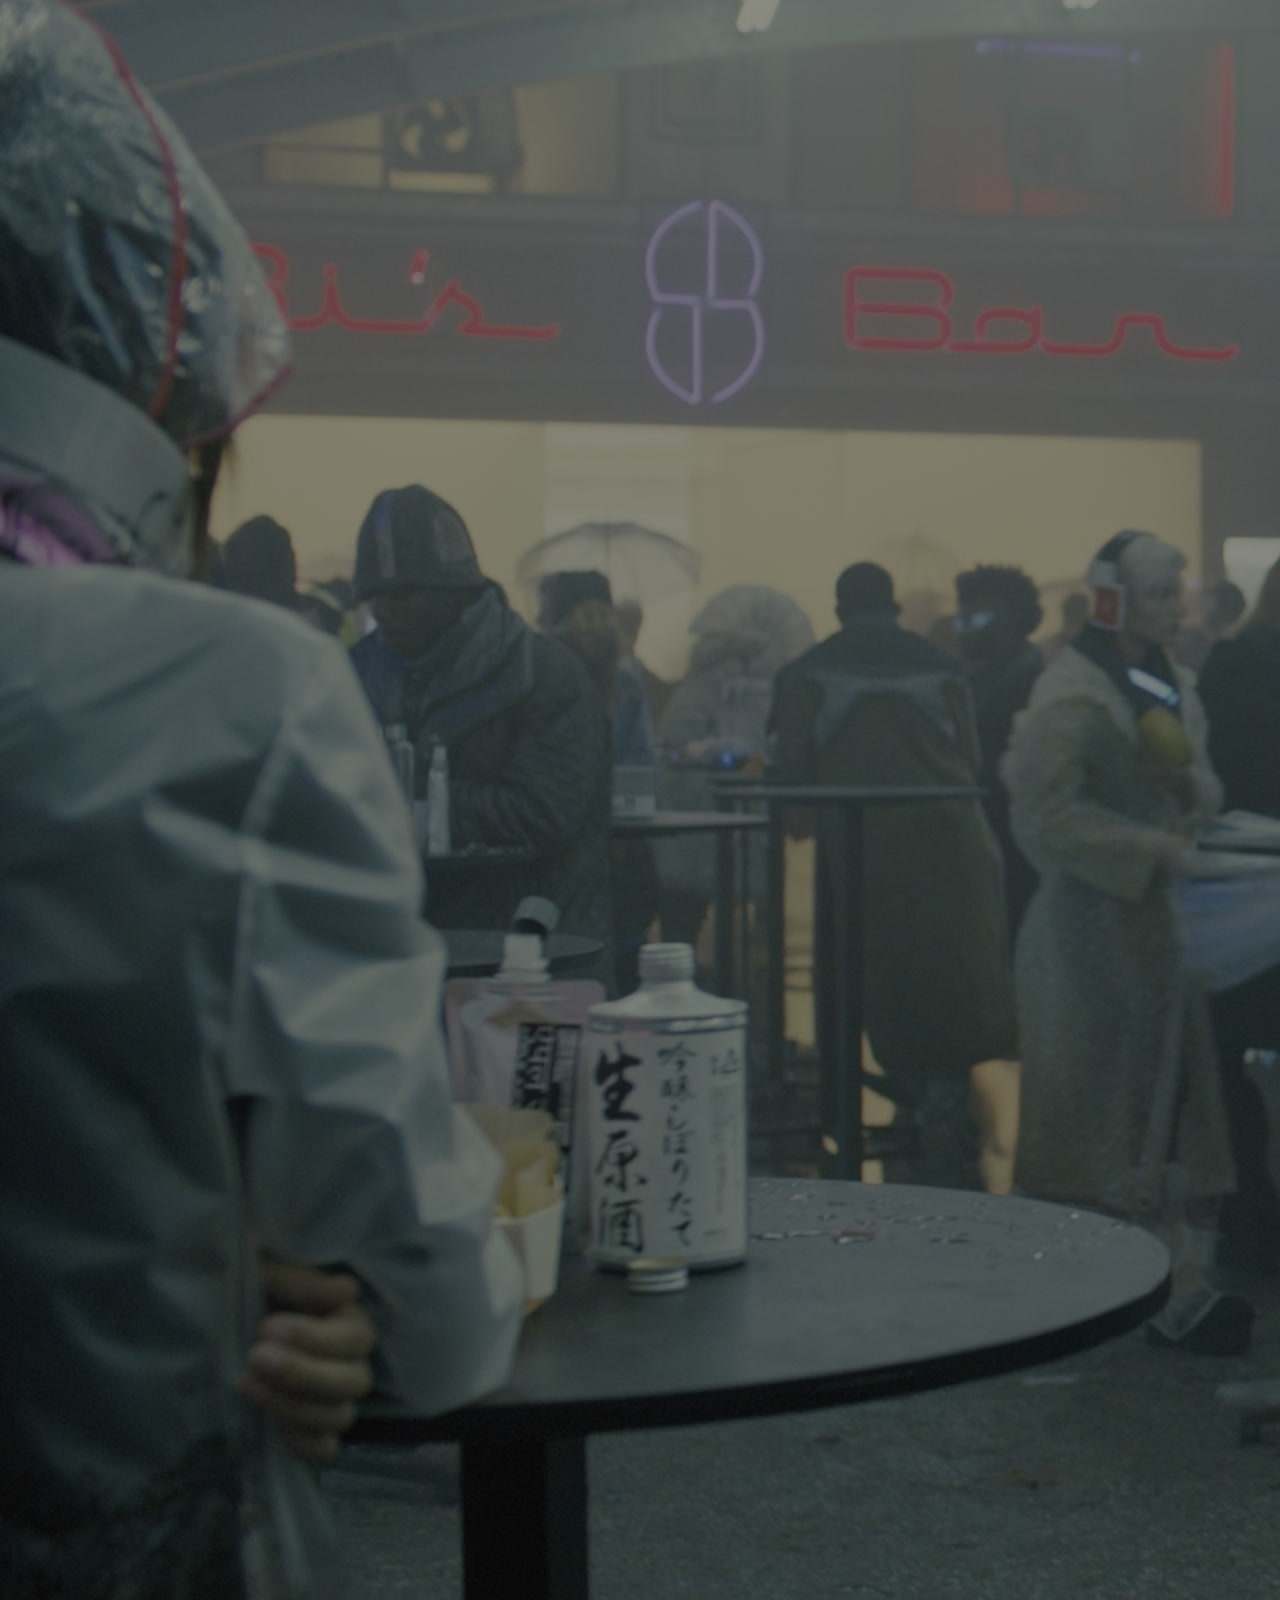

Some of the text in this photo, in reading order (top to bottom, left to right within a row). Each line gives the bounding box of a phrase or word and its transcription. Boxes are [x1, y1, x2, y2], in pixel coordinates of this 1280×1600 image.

[842, 263, 1241, 362] Bar
[594, 1040, 648, 1254] 生原酒
